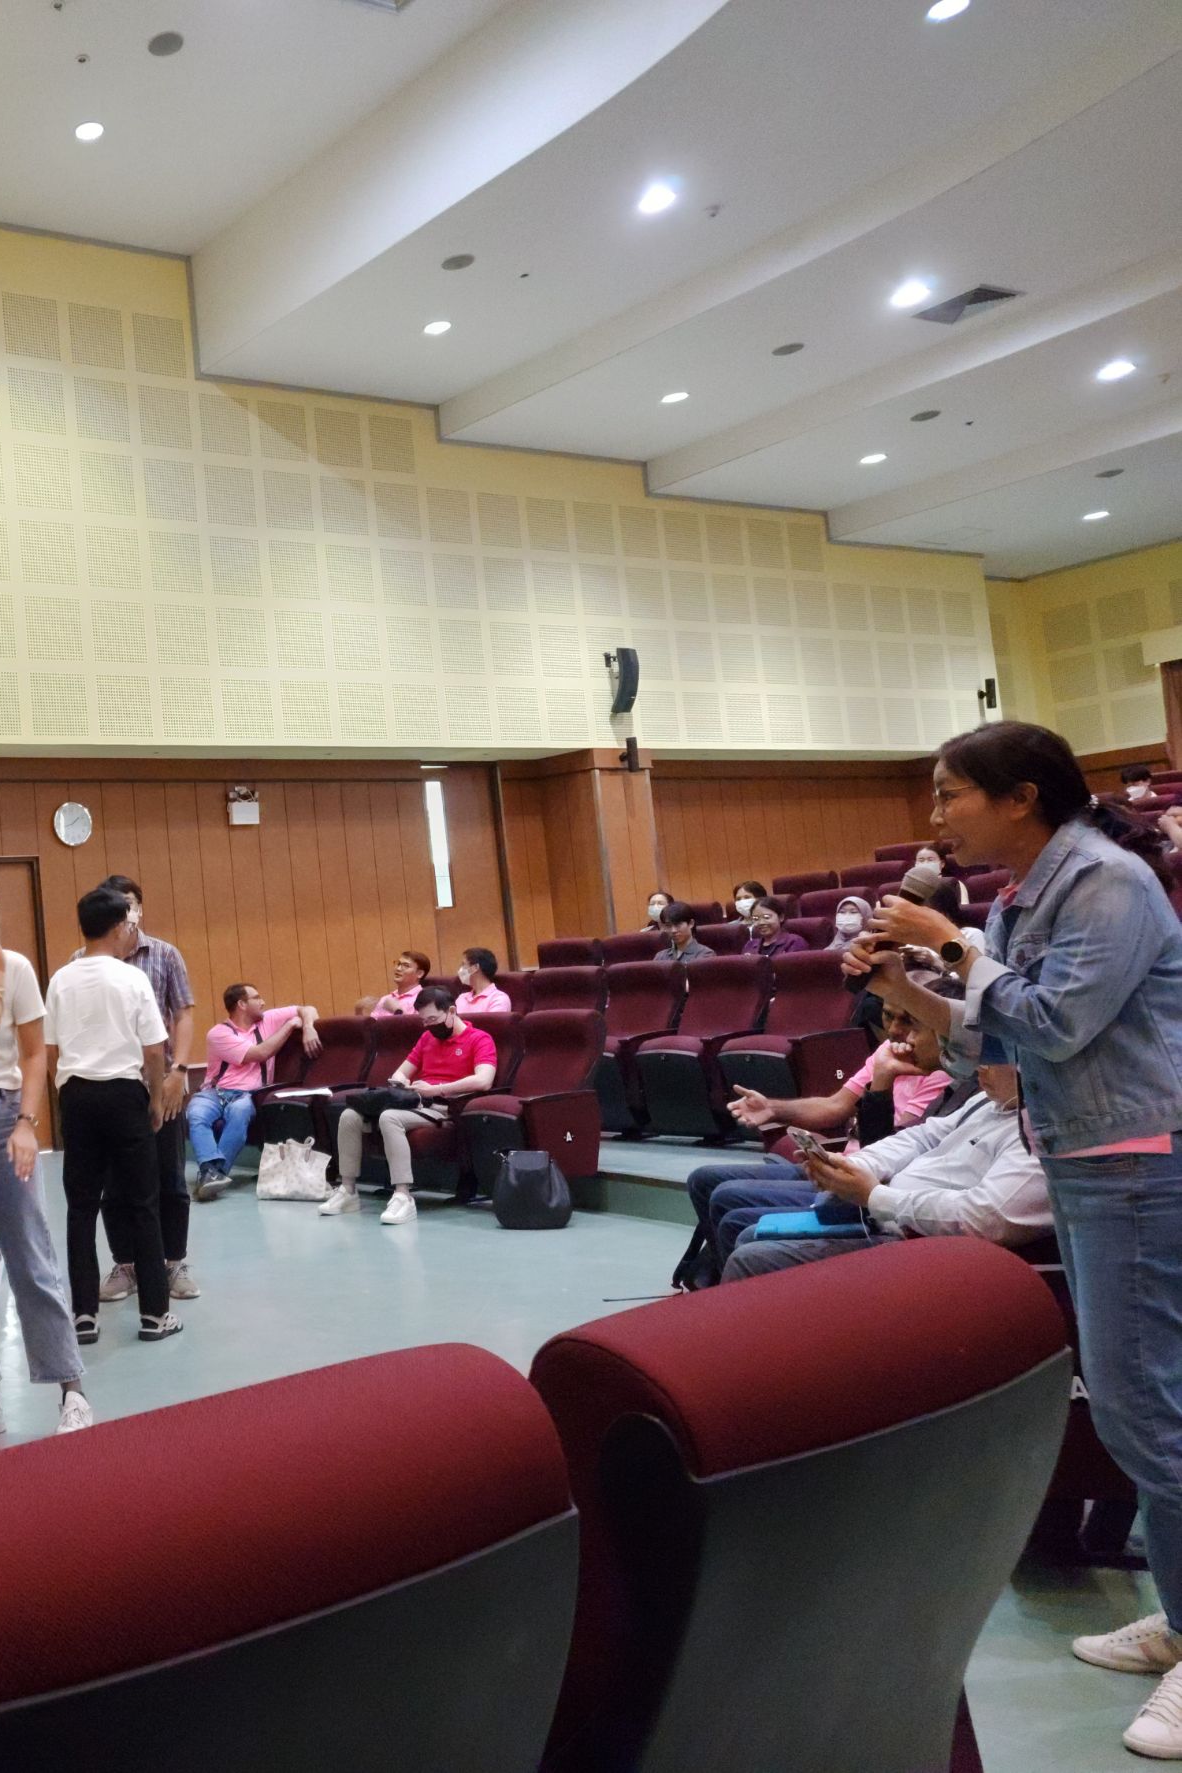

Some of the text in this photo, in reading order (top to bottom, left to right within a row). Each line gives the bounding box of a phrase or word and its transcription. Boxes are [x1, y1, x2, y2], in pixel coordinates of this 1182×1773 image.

[836, 1069, 844, 1080] B
[565, 1131, 573, 1142] A
[1069, 1375, 1089, 1400] A
